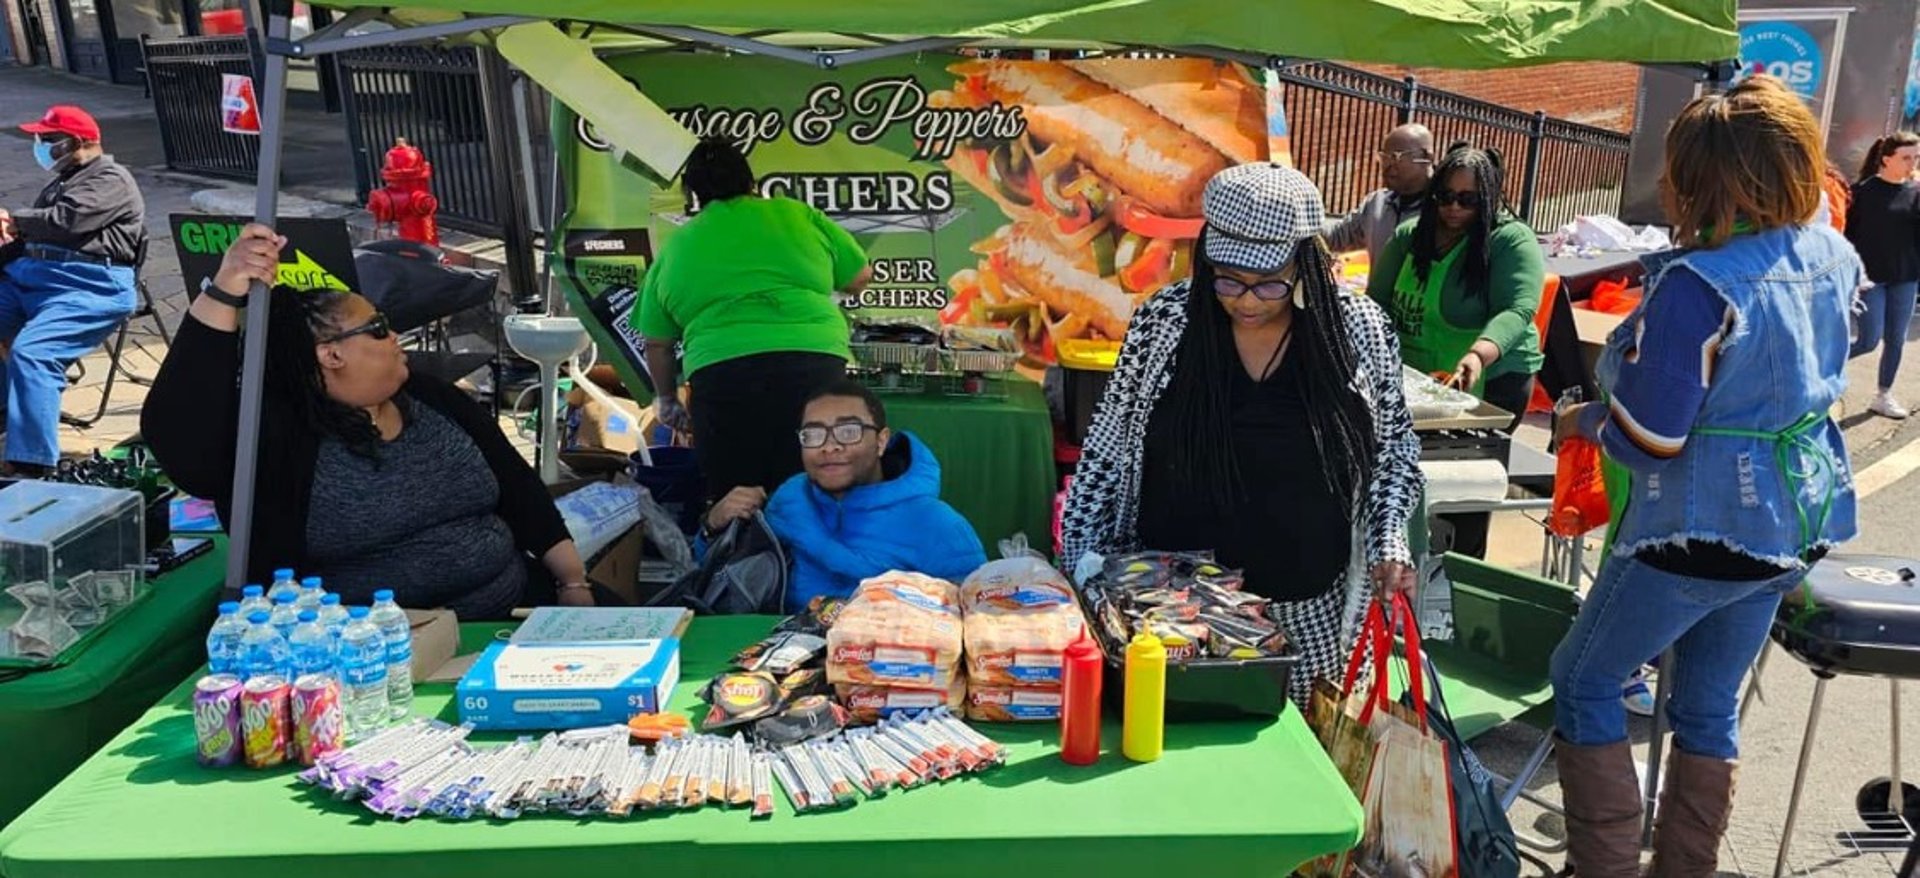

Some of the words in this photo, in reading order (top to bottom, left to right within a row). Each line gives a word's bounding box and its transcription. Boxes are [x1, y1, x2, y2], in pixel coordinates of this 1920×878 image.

[792, 86, 848, 143] &
[850, 80, 1024, 156] Peppers
[690, 175, 951, 212] CHERS
[845, 289, 946, 308] ECHERS
[464, 696, 488, 710] 60
[627, 694, 646, 709] $1
